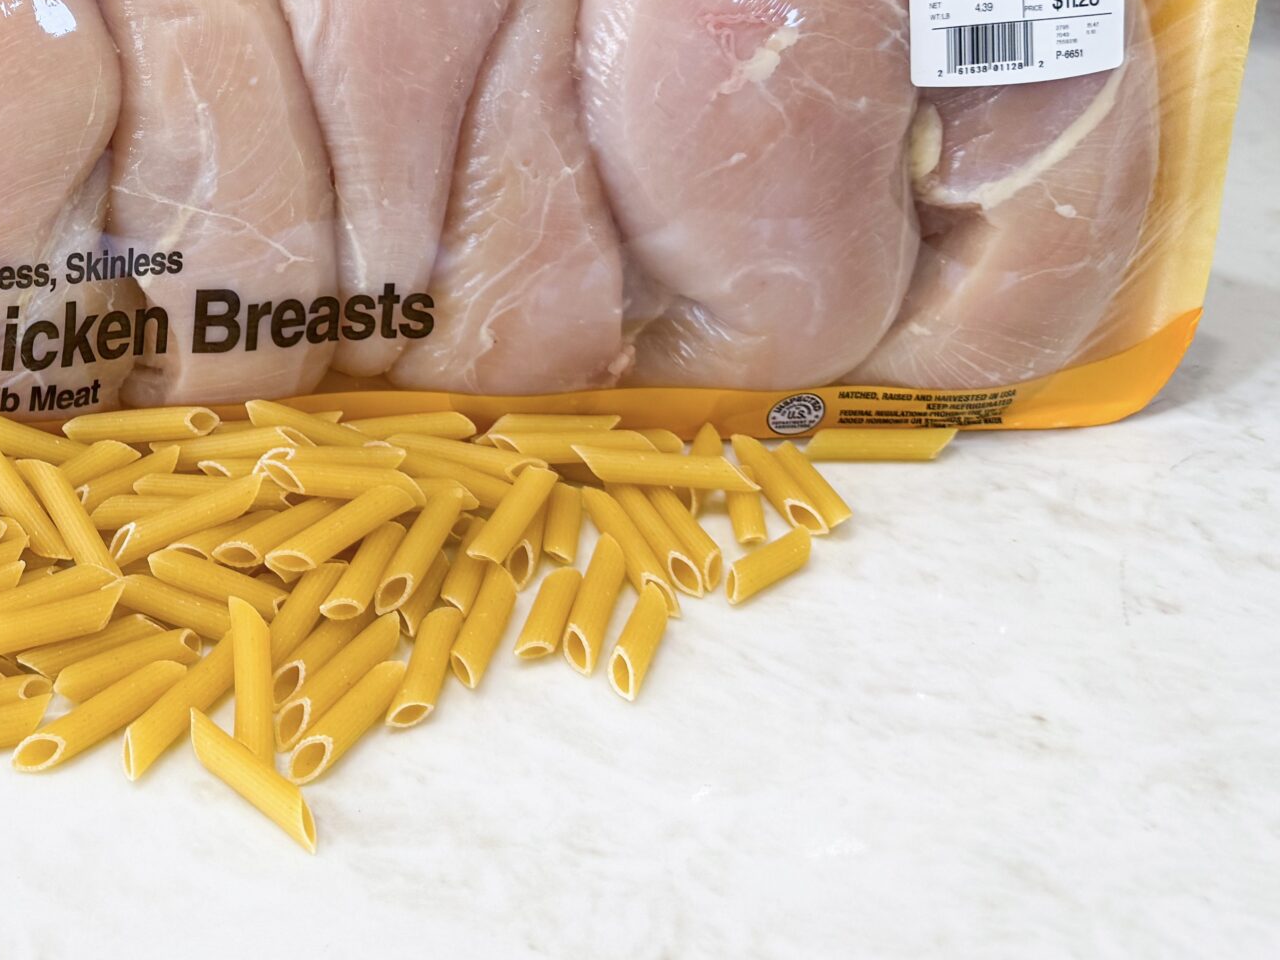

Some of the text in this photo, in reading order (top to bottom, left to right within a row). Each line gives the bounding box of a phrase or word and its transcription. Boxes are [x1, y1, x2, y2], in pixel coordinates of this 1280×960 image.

[975, 2, 993, 12] 4.39
[993, 62, 1023, 71] 01128
[65, 246, 184, 284] Skinless
[191, 282, 435, 355] Breasts
[29, 379, 101, 412] Meat
